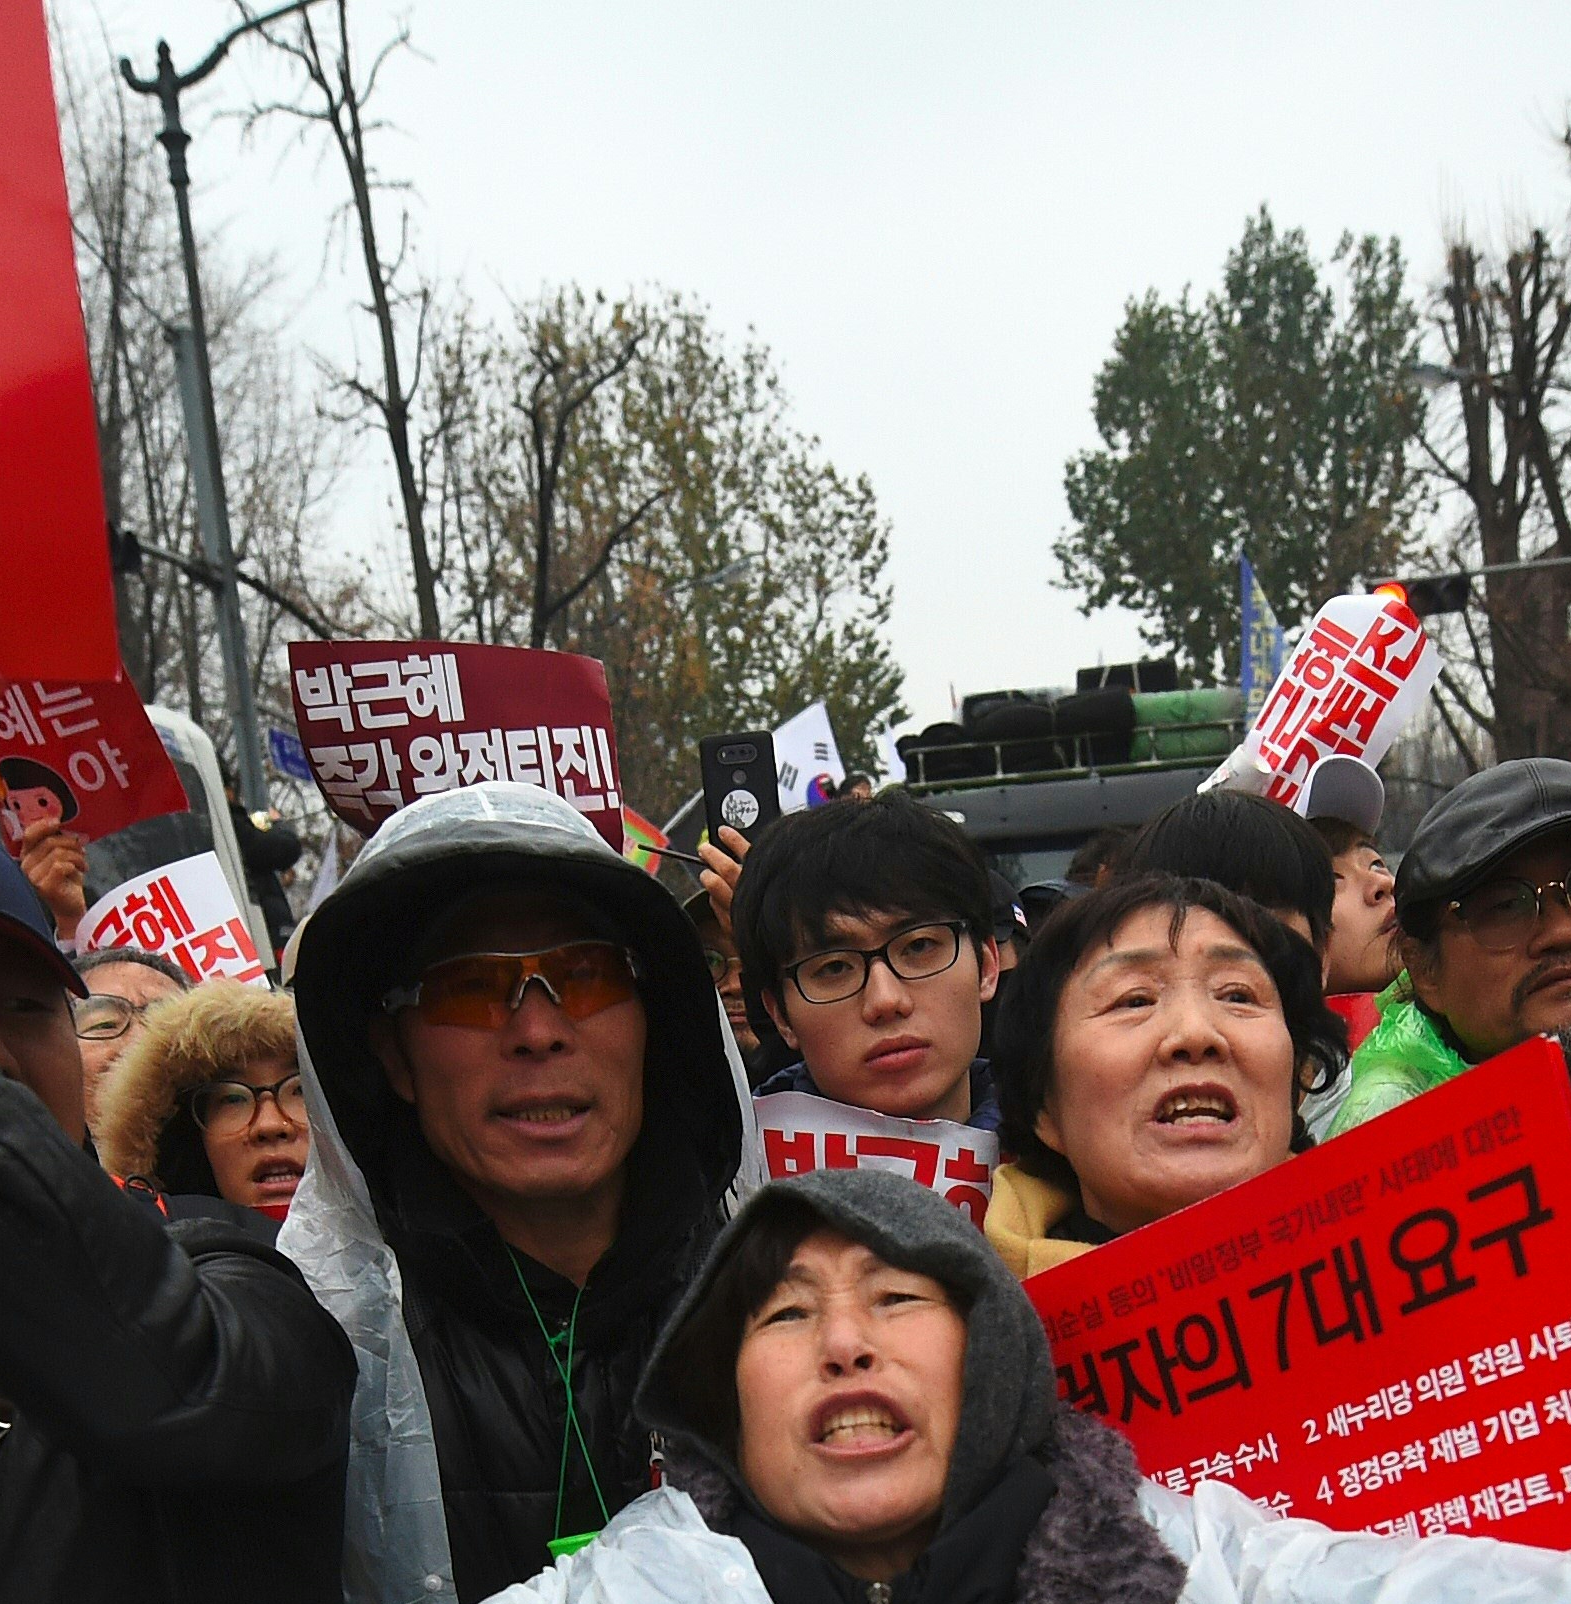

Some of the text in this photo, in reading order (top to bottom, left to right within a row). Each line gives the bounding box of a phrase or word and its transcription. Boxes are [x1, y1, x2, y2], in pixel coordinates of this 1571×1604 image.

[294, 652, 466, 733] 박근혜
[1248, 1236, 1385, 1373] 7대
[1388, 1163, 1555, 1318] 요구
[1301, 1418, 1322, 1445] 2
[1325, 1383, 1414, 1440] 새누리당
[1416, 1358, 1467, 1406] 의원
[1468, 1337, 1525, 1388] 전원
[1315, 1473, 1335, 1507] 4
[1337, 1441, 1429, 1499] 정경유착
[1430, 1420, 1483, 1466] 재벌
[1484, 1400, 1541, 1447] 기업
[1420, 1495, 1473, 1539] 정책
